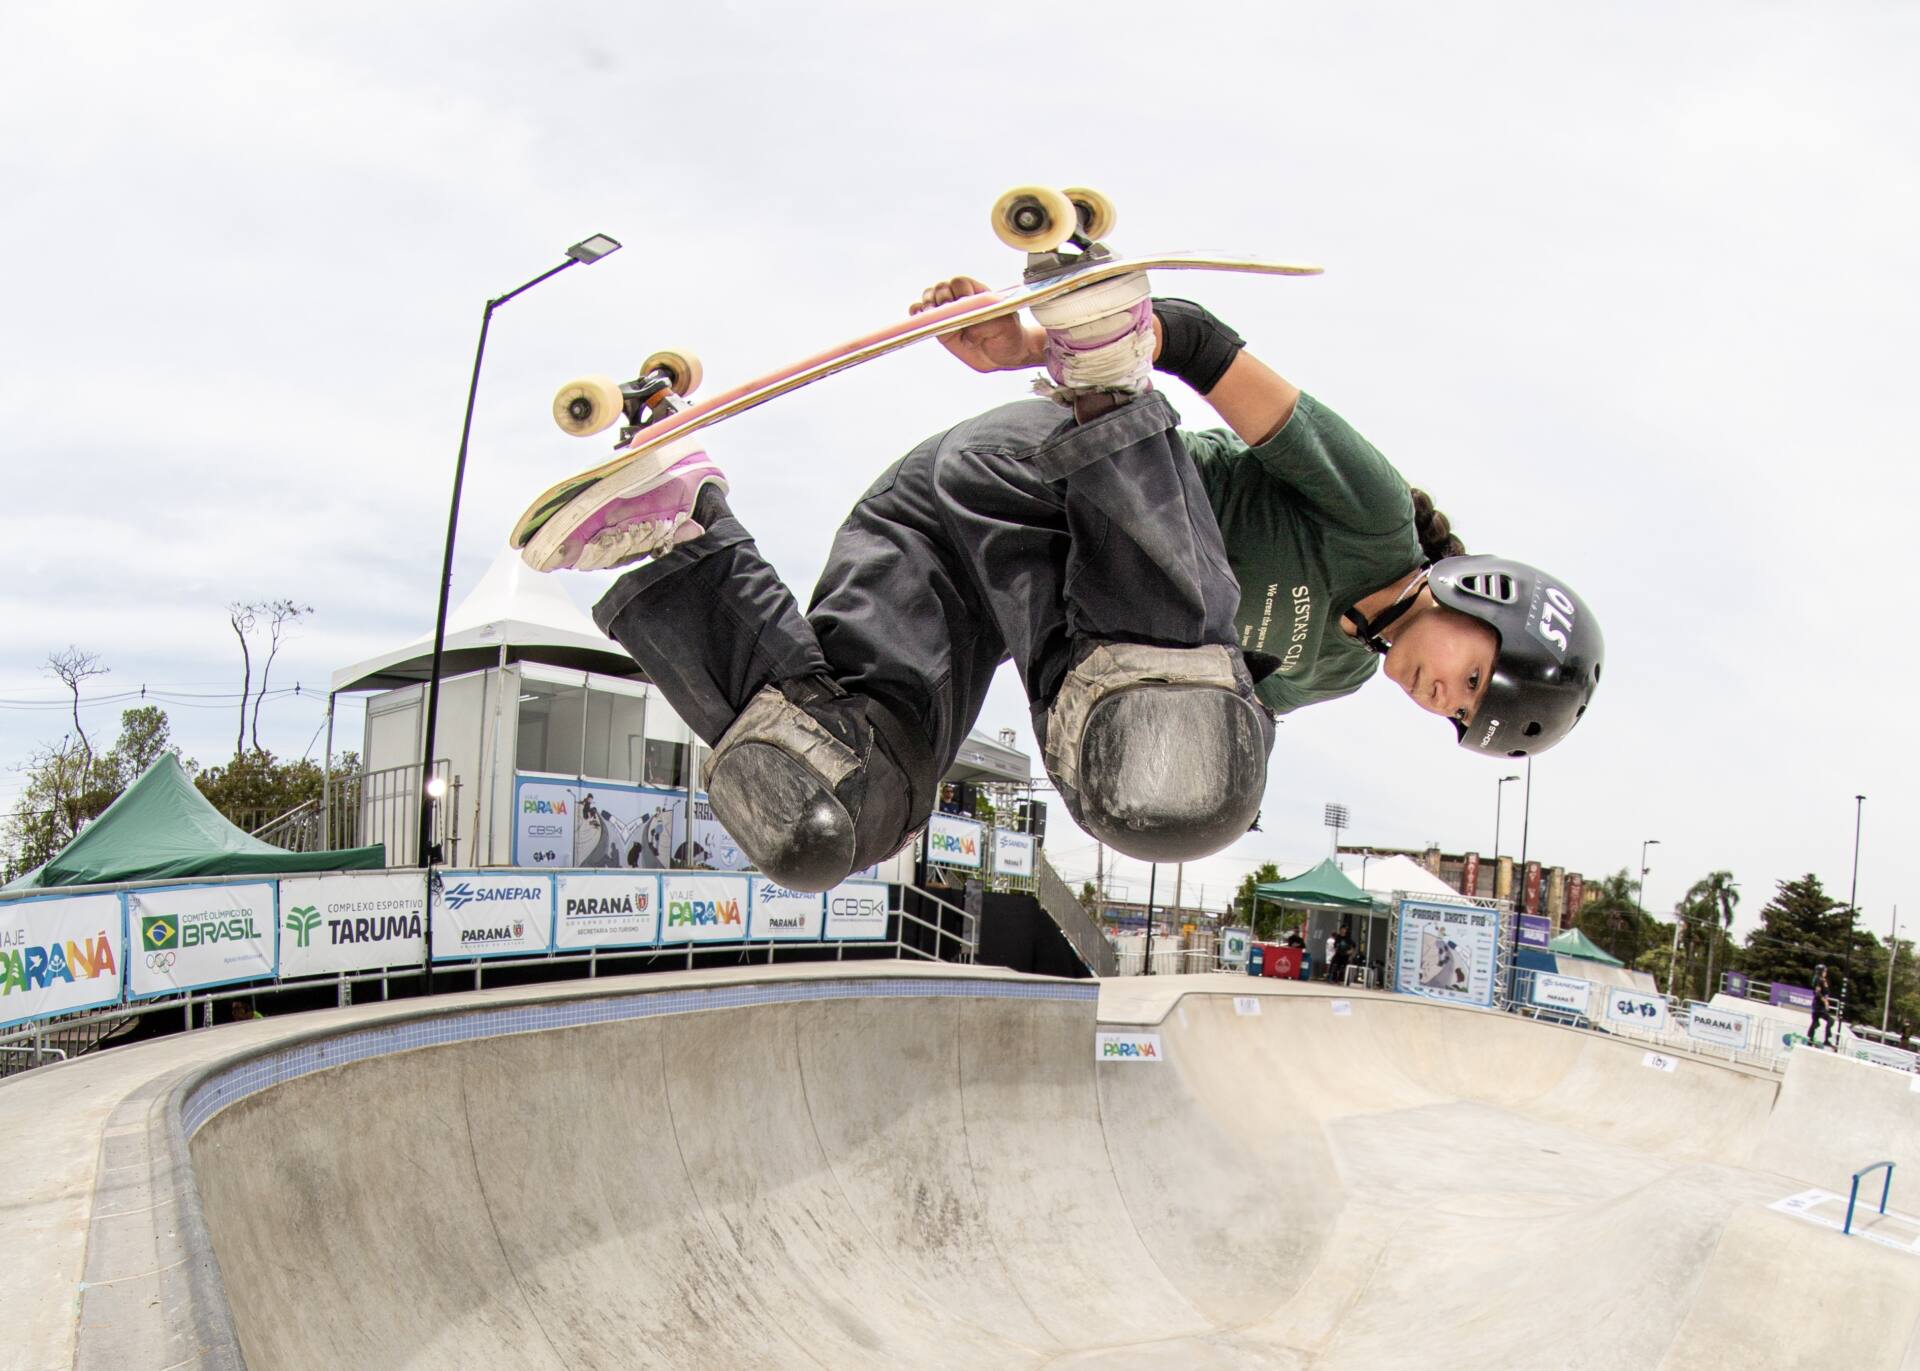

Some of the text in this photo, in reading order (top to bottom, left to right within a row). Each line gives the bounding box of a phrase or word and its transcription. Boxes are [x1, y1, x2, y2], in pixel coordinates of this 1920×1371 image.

[1292, 585, 1311, 642] SISTA'S
[475, 887, 541, 902] SANEPAR
[328, 899, 423, 913] COMPLEXO ESPORTIVO
[567, 894, 633, 915] PARANÁ
[668, 898, 741, 927] PARANÁ
[832, 898, 884, 916] CBSK
[182, 910, 208, 923] COMITÊ
[241, 908, 253, 917] DO
[182, 918, 262, 947] BRASIL
[328, 910, 422, 945] TARUMÃ
[461, 925, 511, 941] PARANÁ
